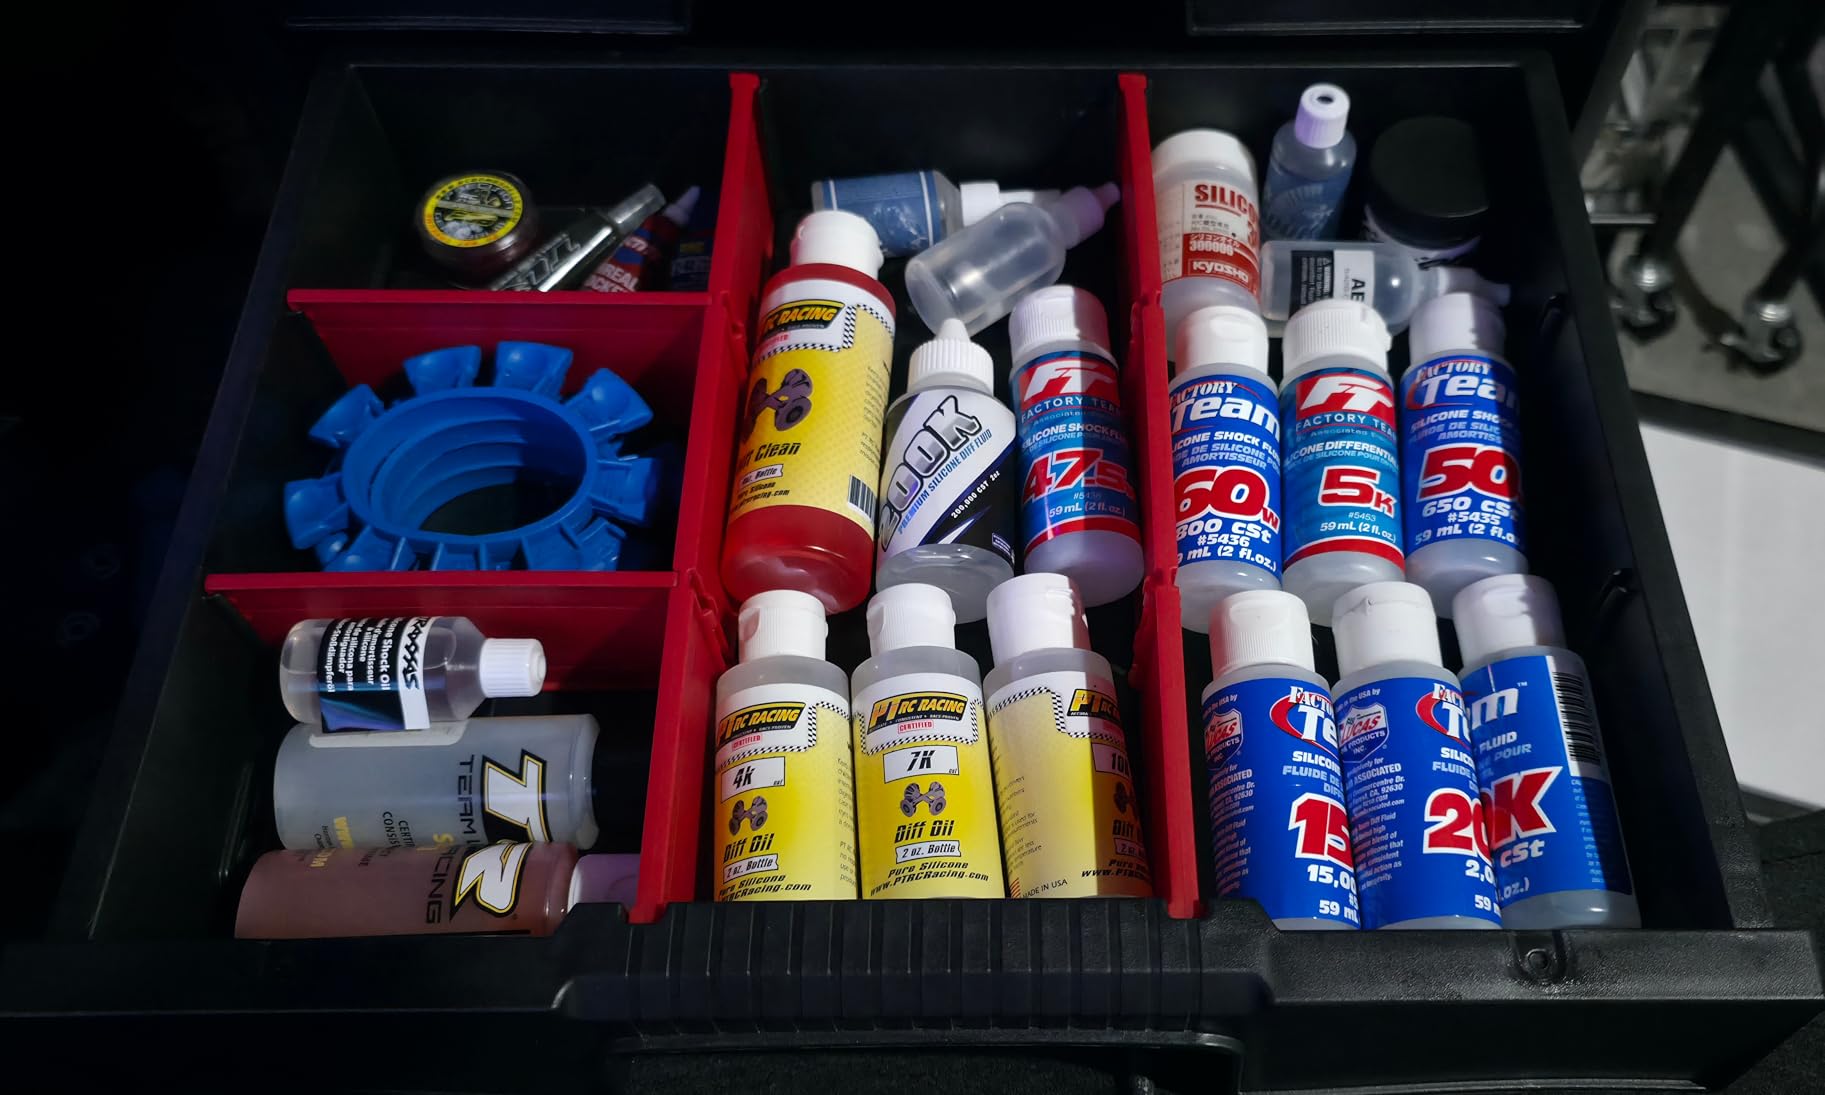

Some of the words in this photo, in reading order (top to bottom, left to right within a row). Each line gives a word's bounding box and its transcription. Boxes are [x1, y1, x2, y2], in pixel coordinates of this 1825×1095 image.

[778, 307, 838, 325] RACING
[1416, 362, 1492, 382] FACTORY
[1021, 396, 1083, 424] FACTORY
[1068, 423, 1109, 435] SHOCK
[1171, 397, 1280, 443] Team
[1296, 413, 1367, 433] FACTORY
[1411, 410, 1468, 433] SILICONE
[1448, 422, 1468, 430] DE
[1039, 433, 1076, 448] SILICONE
[1214, 431, 1260, 447] SHOCK
[755, 443, 801, 462] Clean
[1181, 452, 1267, 470] AMORTISSEUR
[1192, 445, 1209, 455] DE
[1211, 443, 1265, 461] SILICONE
[1315, 449, 1357, 459] SILICONE
[1357, 451, 1381, 462] POUR
[755, 467, 778, 480] Bottle
[878, 395, 982, 552] 200K
[897, 491, 930, 535] PREMIUM
[929, 458, 962, 491] SILICONE
[961, 445, 976, 462] DIFF
[975, 428, 993, 448] FLUID
[951, 492, 978, 519] 200,000
[1049, 506, 1063, 518] 59
[1064, 502, 1083, 512] mL
[1085, 502, 1096, 512] (2
[1422, 496, 1471, 518] 650
[1348, 512, 1376, 523] #5453
[1448, 511, 1501, 525] #5435
[1176, 518, 1223, 541] 800
[1231, 520, 1273, 544] cSt
[1320, 521, 1336, 532] 59
[1337, 521, 1356, 531] mL
[1358, 522, 1370, 533] (2
[1371, 523, 1382, 536] fl.
[1382, 530, 1397, 544] oz.)
[1415, 528, 1432, 545] 59
[1436, 523, 1462, 537] mL
[1468, 523, 1485, 535] (2
[1197, 534, 1250, 547] #5436
[1187, 546, 1211, 561] mL
[1217, 545, 1234, 557] (2
[346, 636, 359, 669] silicona
[358, 631, 372, 663] silicone
[379, 638, 393, 673] Shock
[344, 670, 354, 691] para
[379, 673, 392, 691] Oil
[1070, 689, 1101, 713] PT
[1358, 690, 1371, 699] USA
[1371, 688, 1381, 696] by
[869, 700, 900, 728] PT
[898, 700, 917, 714] RC
[915, 698, 965, 714] RACING
[717, 715, 735, 746] PT
[733, 716, 748, 732] RC
[748, 708, 801, 728] RACING
[899, 721, 933, 733] CERTIFIED
[732, 735, 762, 749] CERTIFIED
[1348, 730, 1386, 749] PRODUCTS
[1479, 731, 1518, 754] FLUID
[1494, 743, 1532, 760] POUR
[907, 750, 935, 772] 7K
[1373, 757, 1384, 765] for
[1432, 761, 1471, 778] FLUIDE
[1282, 765, 1328, 781] FLUIDE
[1354, 762, 1402, 785] ASSOCIATED
[1395, 775, 1406, 783] Dr.
[457, 754, 477, 835] TEAM
[1380, 783, 1404, 795] 92630
[1380, 811, 1397, 822] Fluid
[894, 821, 926, 843] Diff
[930, 819, 954, 837] Oil
[1389, 831, 1398, 839] of
[723, 837, 748, 864] Diff
[750, 832, 775, 853] Oil
[902, 848, 909, 859] 2
[910, 846, 924, 857] oz.
[927, 842, 956, 854] Bottle
[1389, 839, 1404, 849] that
[726, 867, 732, 878] 2
[733, 864, 744, 875] oz.
[746, 858, 773, 872] Bottle
[888, 864, 917, 879] Pure
[918, 860, 969, 871] Silicone
[1108, 859, 1134, 868] Pure
[738, 874, 786, 889] Silicone
[869, 869, 989, 897] www.PTRCRacing.com
[1051, 879, 1068, 890] USA
[1319, 900, 1341, 915] 59
[1474, 895, 1491, 912] 59
